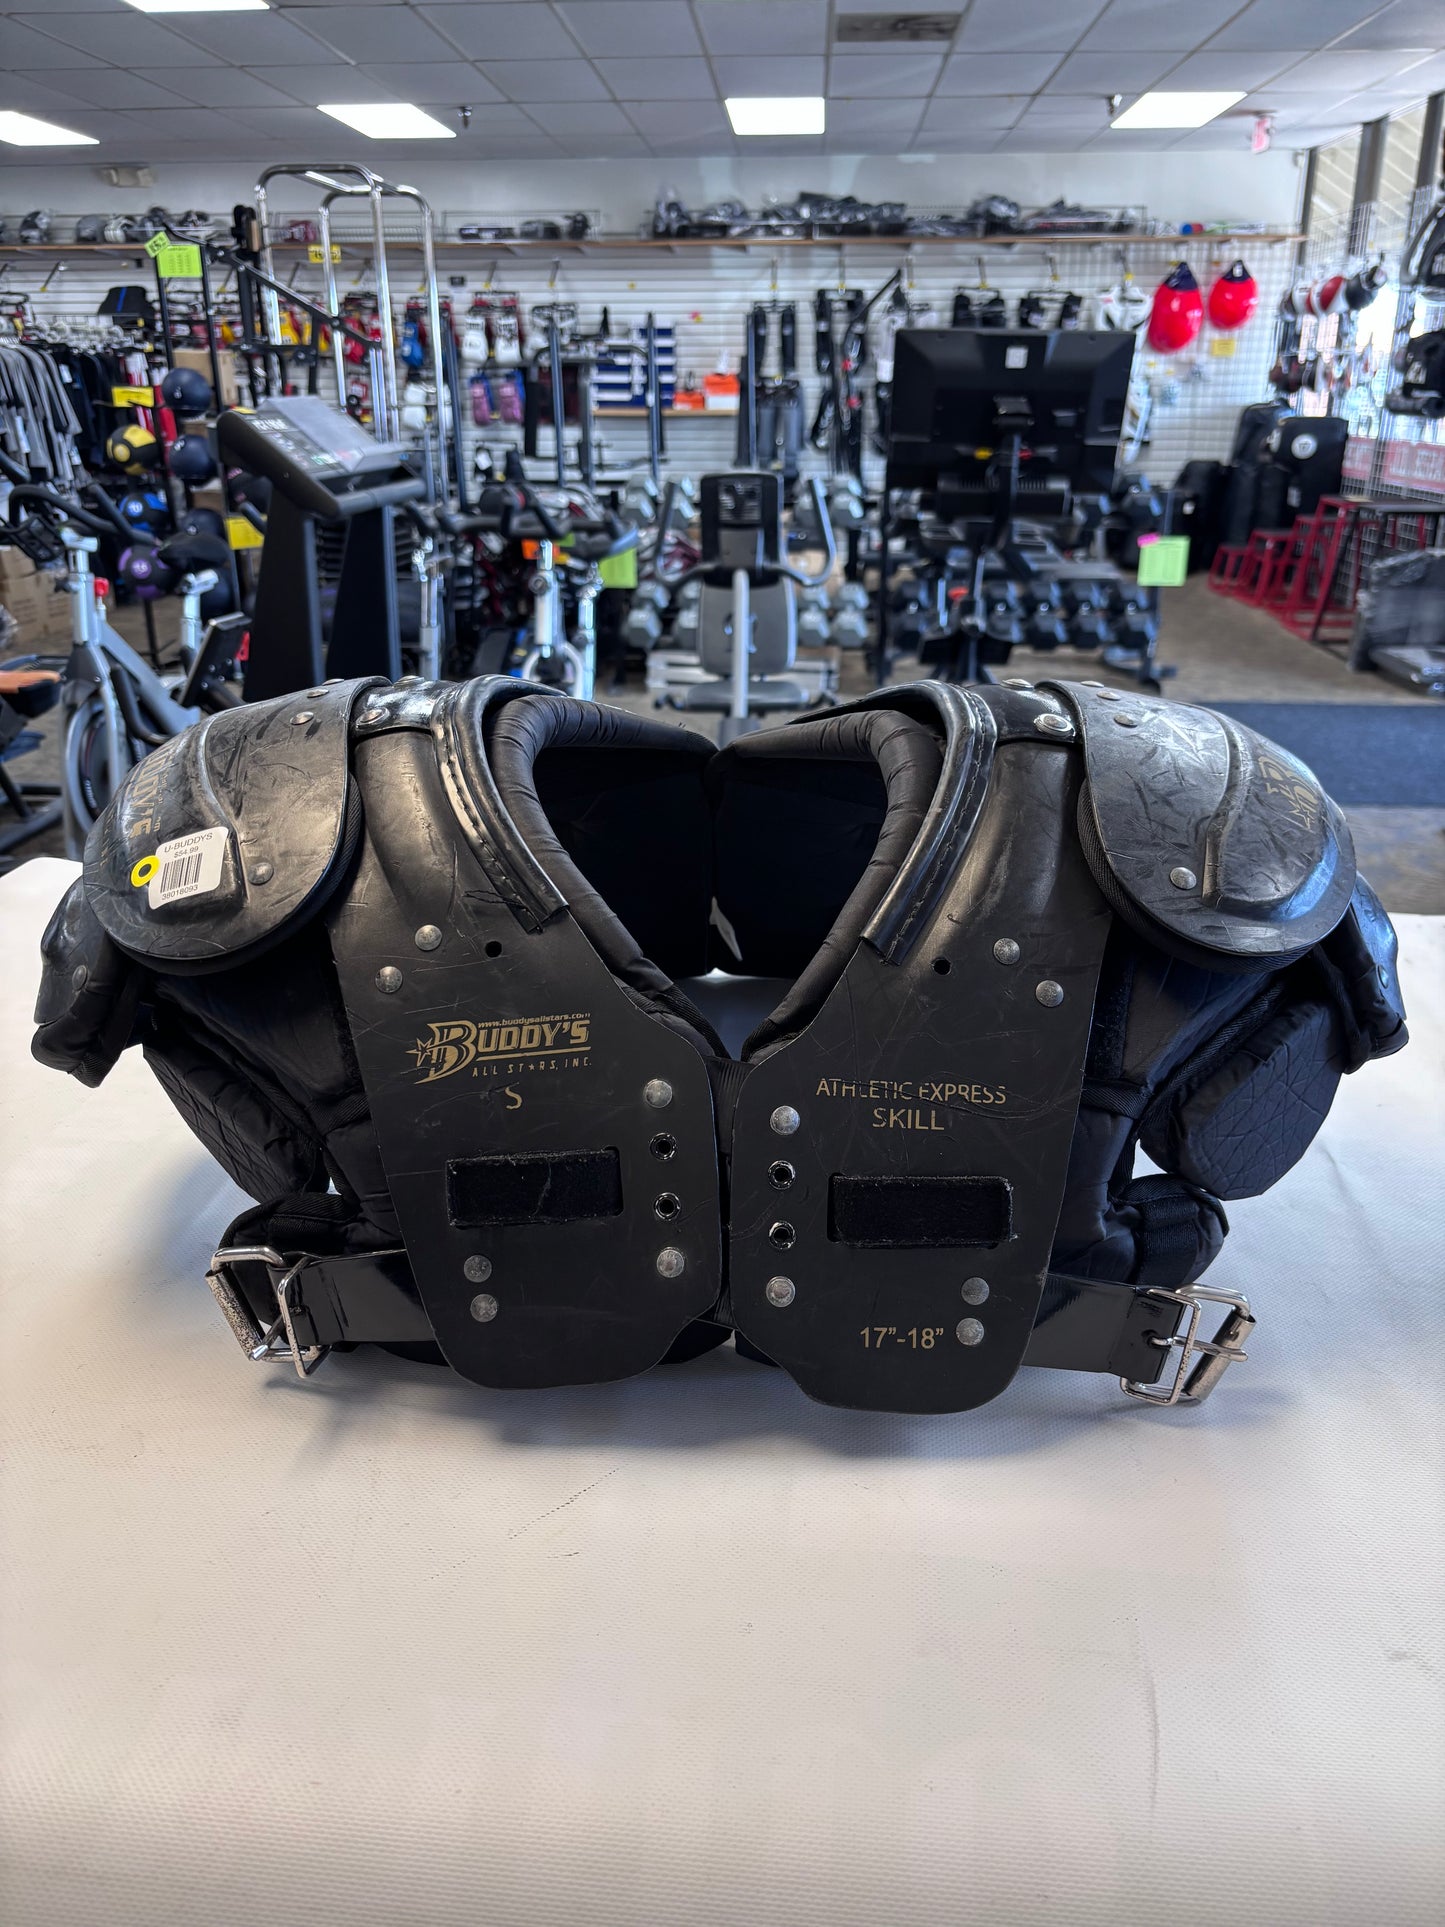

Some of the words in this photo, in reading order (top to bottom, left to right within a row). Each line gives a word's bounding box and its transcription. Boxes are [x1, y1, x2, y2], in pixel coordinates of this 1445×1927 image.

[164, 832, 213, 853] U-BUDDYS
[174, 845, 199, 858] $54.99
[161, 884, 199, 900] 38018093
[414, 1019, 591, 1084] BUDDY'S
[472, 1066, 498, 1077] ALL
[565, 1056, 592, 1069] INC.
[504, 1086, 523, 1110] S
[816, 1078, 912, 1100] ATHLETIC
[918, 1082, 1007, 1104] EXPRESS
[872, 1107, 945, 1130] SKILL
